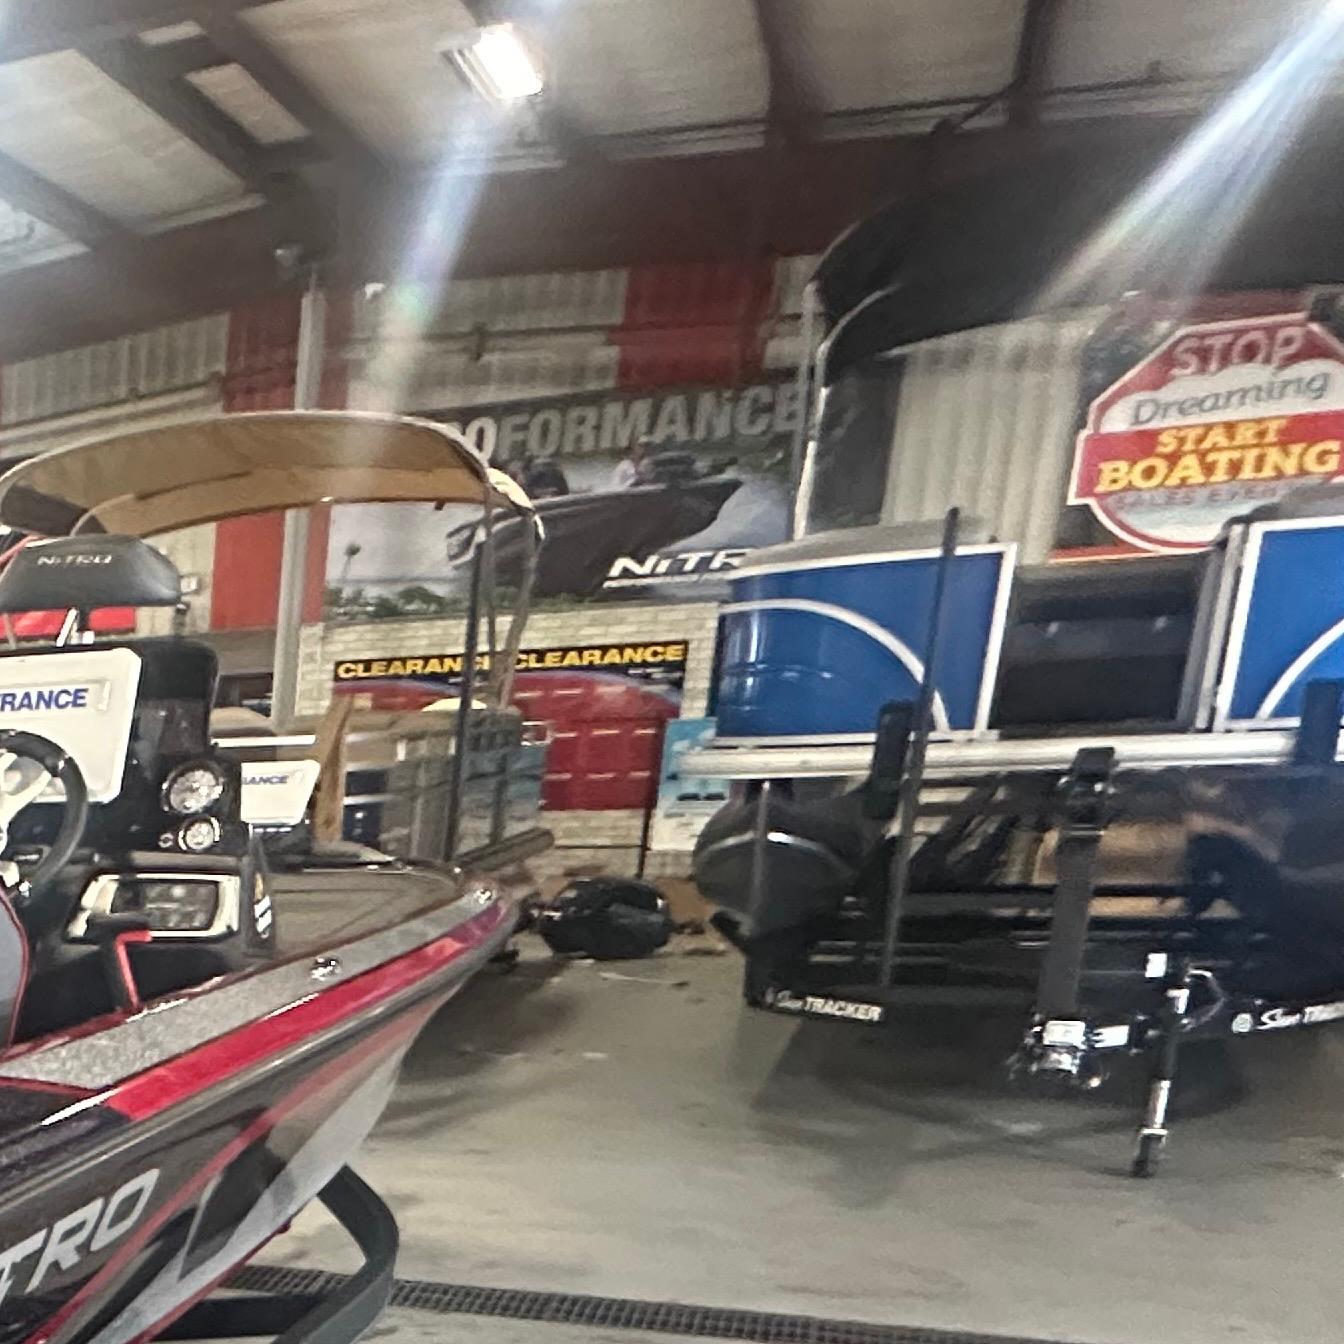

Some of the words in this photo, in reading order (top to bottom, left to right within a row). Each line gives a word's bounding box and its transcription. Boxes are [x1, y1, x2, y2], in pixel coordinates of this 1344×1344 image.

[1170, 326, 1306, 377] STOP
[1130, 370, 1331, 427] Dreaming
[447, 383, 806, 462] OFORMANCE
[1155, 419, 1289, 454] START
[1094, 439, 1342, 494] BOATING
[609, 548, 750, 579] NITR
[514, 644, 685, 669] CLEARANCE
[805, 995, 883, 1022] TRACKER
